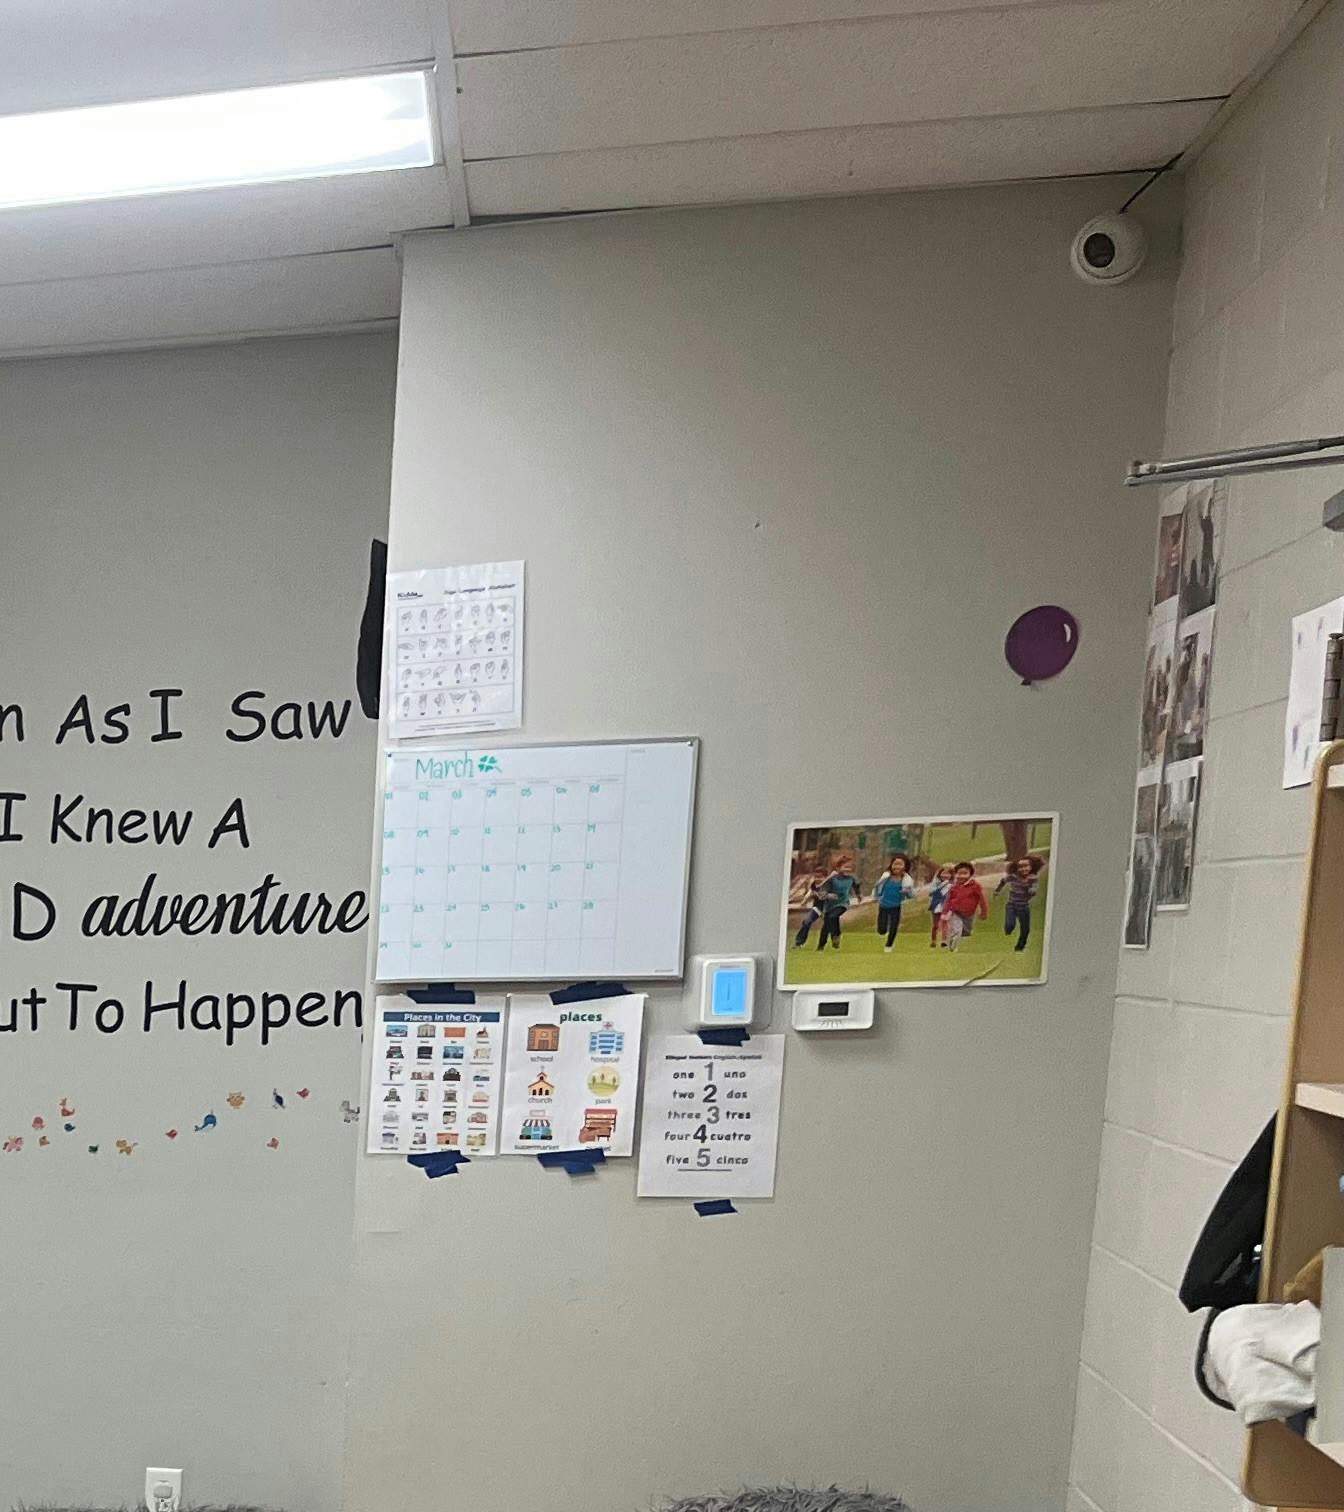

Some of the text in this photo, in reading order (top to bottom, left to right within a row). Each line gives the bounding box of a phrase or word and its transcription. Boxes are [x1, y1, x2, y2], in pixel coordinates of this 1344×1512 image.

[55, 694, 131, 745] As
[149, 688, 183, 743] I
[226, 690, 352, 743] Saw
[415, 752, 474, 780] March
[51, 793, 193, 846] Knew
[208, 798, 250, 849] A
[81, 873, 370, 937] adventure
[55, 982, 124, 1033] To
[143, 980, 363, 1046] Happen
[446, 1013, 461, 1021] the
[463, 1014, 481, 1022] City
[560, 1011, 602, 1024] places
[673, 1062, 746, 1081] one 1 uno
[673, 1090, 695, 1099] two
[702, 1084, 718, 1103] 2
[668, 1106, 751, 1124] three 3 tres
[664, 1124, 751, 1143] four 4 cuatro
[666, 1148, 749, 1167] five 5 cinco
